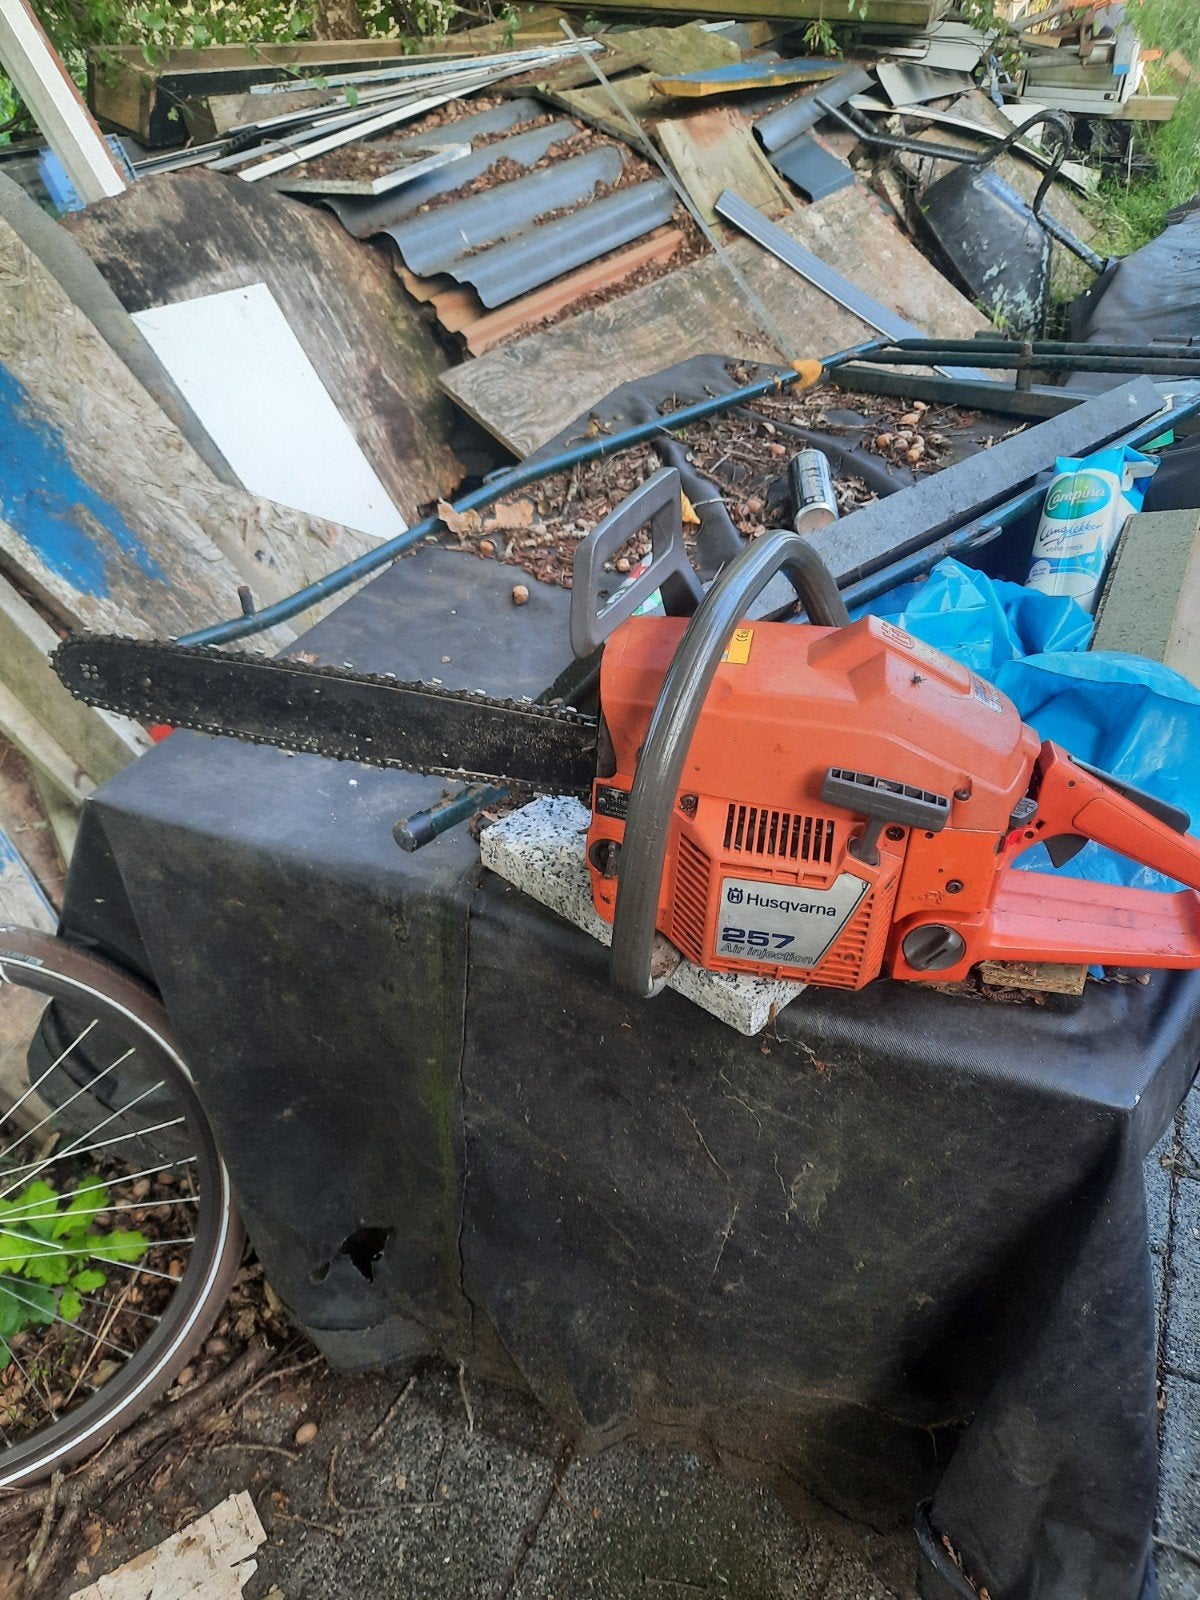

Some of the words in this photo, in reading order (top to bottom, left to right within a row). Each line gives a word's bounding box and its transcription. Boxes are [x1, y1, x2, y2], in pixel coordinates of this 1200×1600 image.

[1047, 486, 1105, 510] Campina
[746, 892, 837, 917] Husqvarna
[722, 927, 795, 949] 257
[720, 942, 745, 953] Air
[746, 946, 813, 964] injection
